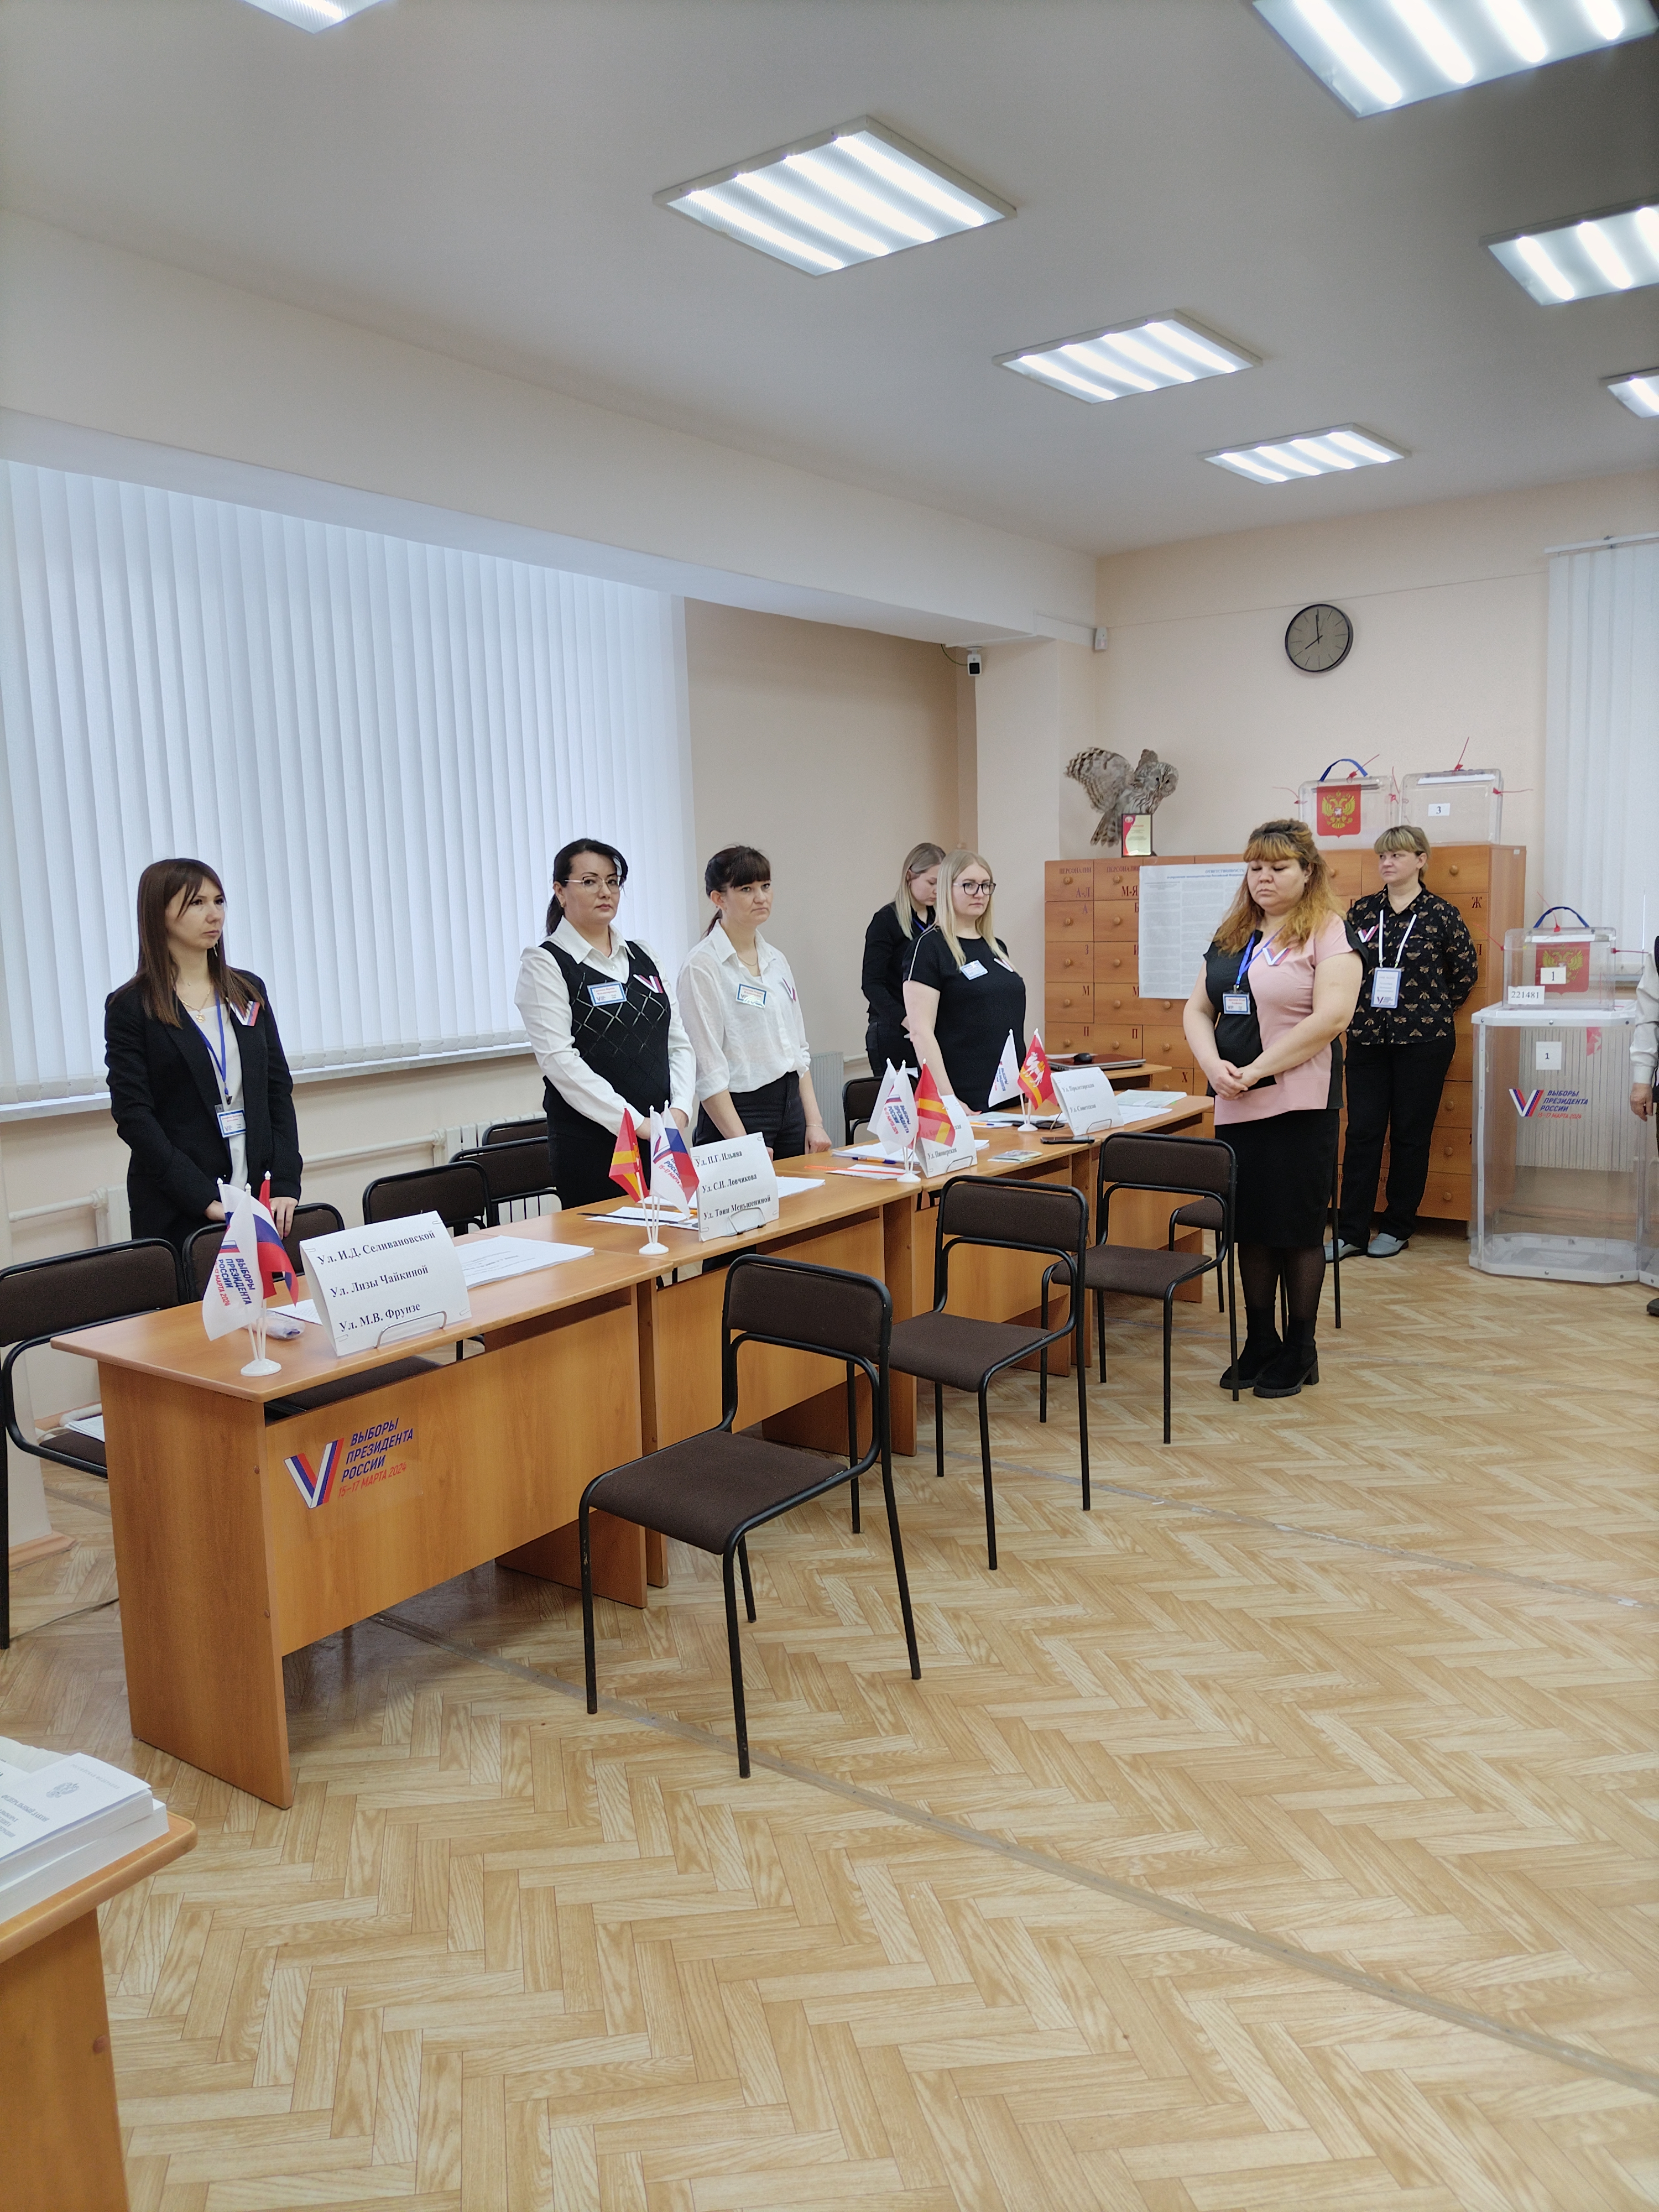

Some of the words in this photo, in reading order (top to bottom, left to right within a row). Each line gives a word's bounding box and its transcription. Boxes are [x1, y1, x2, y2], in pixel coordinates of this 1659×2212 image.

[1076, 887, 1091, 898] А-Л
[1121, 885, 1138, 897] М-Я
[1082, 903, 1088, 914] А
[1471, 896, 1483, 909] Ж
[1552, 971, 1554, 982] 1
[1082, 985, 1089, 995] М
[1084, 1026, 1089, 1036] П
[1132, 1029, 1138, 1039] П
[1182, 1072, 1188, 1083] Х
[695, 1159, 707, 1167] Ул.
[708, 1154, 721, 1164] П.Г.
[722, 1151, 742, 1160] Ильина
[702, 1185, 712, 1193] Ул.
[727, 1174, 757, 1187] Ловчикова
[703, 1212, 713, 1220] Ул.
[715, 1207, 729, 1217] Тони
[731, 1194, 771, 1212] Меньшениной
[316, 1255, 337, 1265] Ул.
[337, 1248, 361, 1260] И.Д.
[362, 1230, 436, 1254] Селивановской
[215, 1274, 225, 1292] МАРТА
[218, 1259, 234, 1288] РОССИИ
[225, 1259, 252, 1305] ПРЕЗИДЕНТА
[235, 1258, 255, 1290] ВЫБОРЫ
[330, 1287, 349, 1298] Ул.
[351, 1279, 379, 1293] Лизы
[379, 1264, 429, 1284] Чайкиной
[339, 1321, 357, 1332] Ул.
[359, 1312, 383, 1327] М.В.
[385, 1303, 421, 1319] Фрунзе
[351, 1417, 399, 1447] ВЫБОРЫ
[346, 1428, 413, 1465] ПРЕЗИДЕНТА
[341, 1454, 386, 1483] РОССИИ
[361, 1469, 387, 1489] МАРТА
[388, 1462, 407, 1478] 2024
